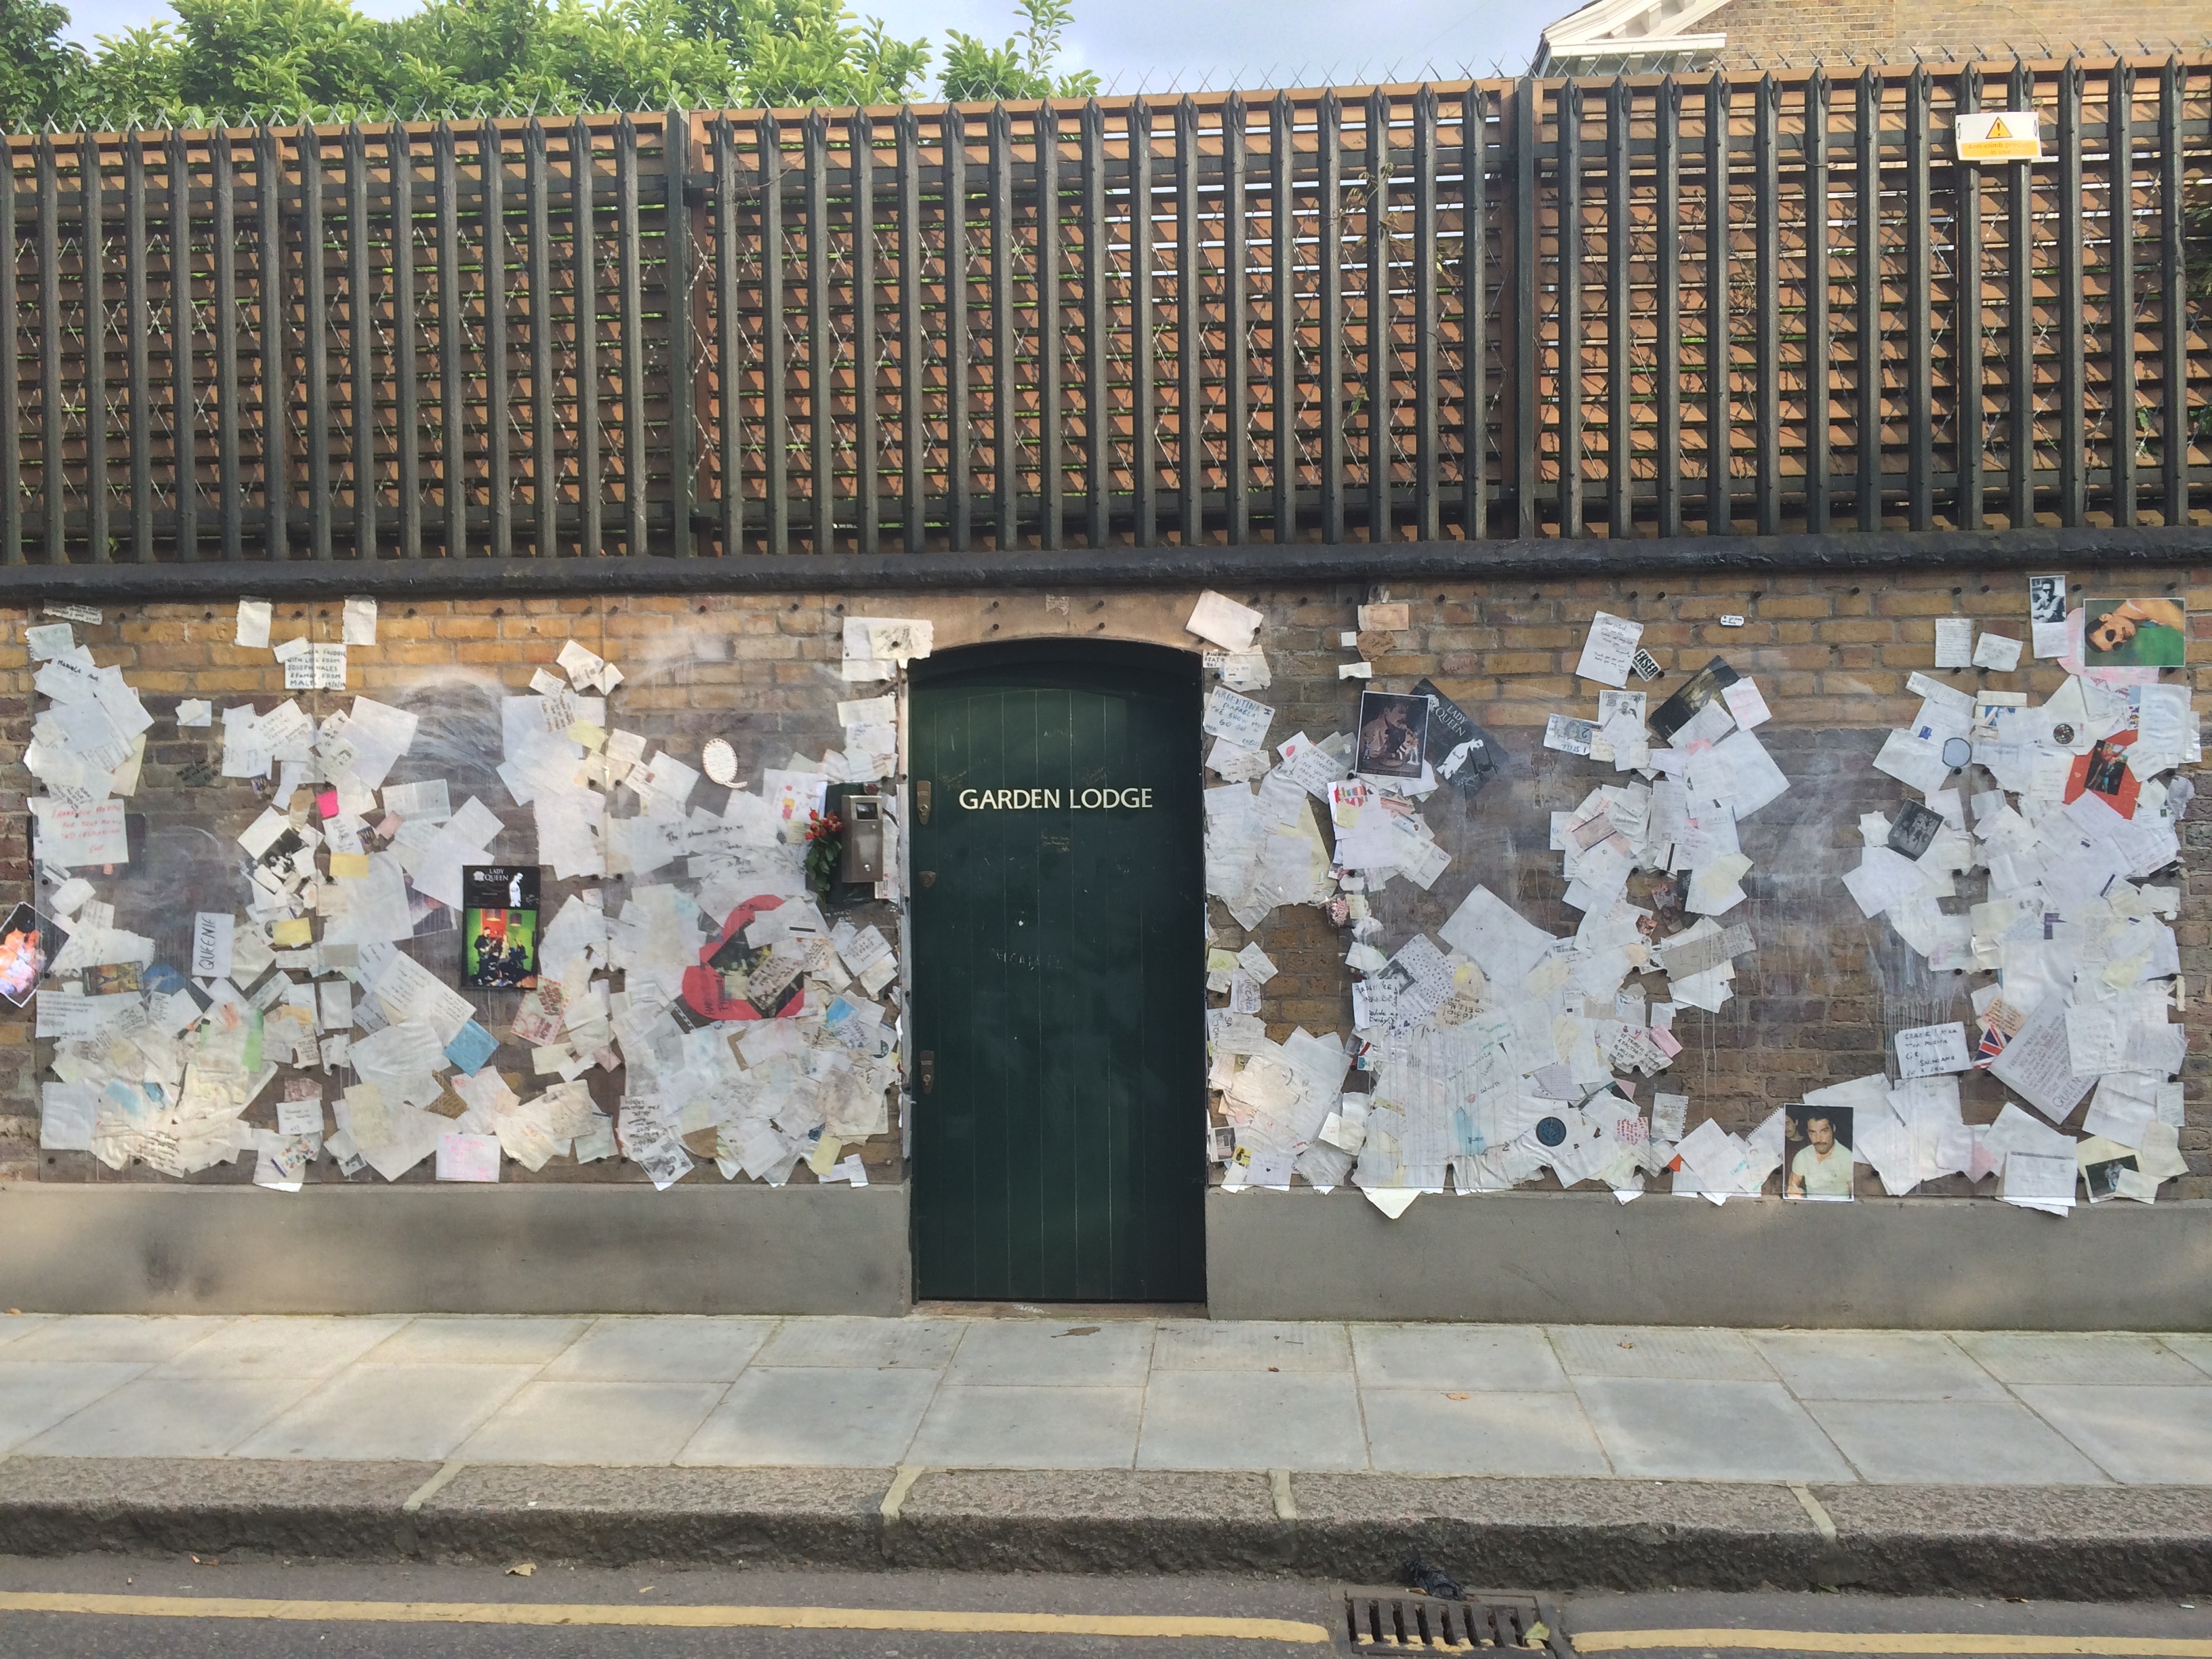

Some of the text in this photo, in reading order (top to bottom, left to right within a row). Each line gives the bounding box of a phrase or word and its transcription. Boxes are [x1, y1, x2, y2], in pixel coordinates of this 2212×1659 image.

[1633, 650, 1660, 677] EKSER
[1215, 690, 1261, 712] ARGENTINA
[1219, 718, 1231, 727] GO
[1435, 708, 1466, 737] QUEEN
[1446, 705, 1469, 724] LADY
[1561, 743, 1580, 753] STILL
[959, 787, 1153, 809] GARDEN LODGE
[484, 874, 509, 882] QUEEN
[2049, 1074, 2085, 1109] QUEEN
